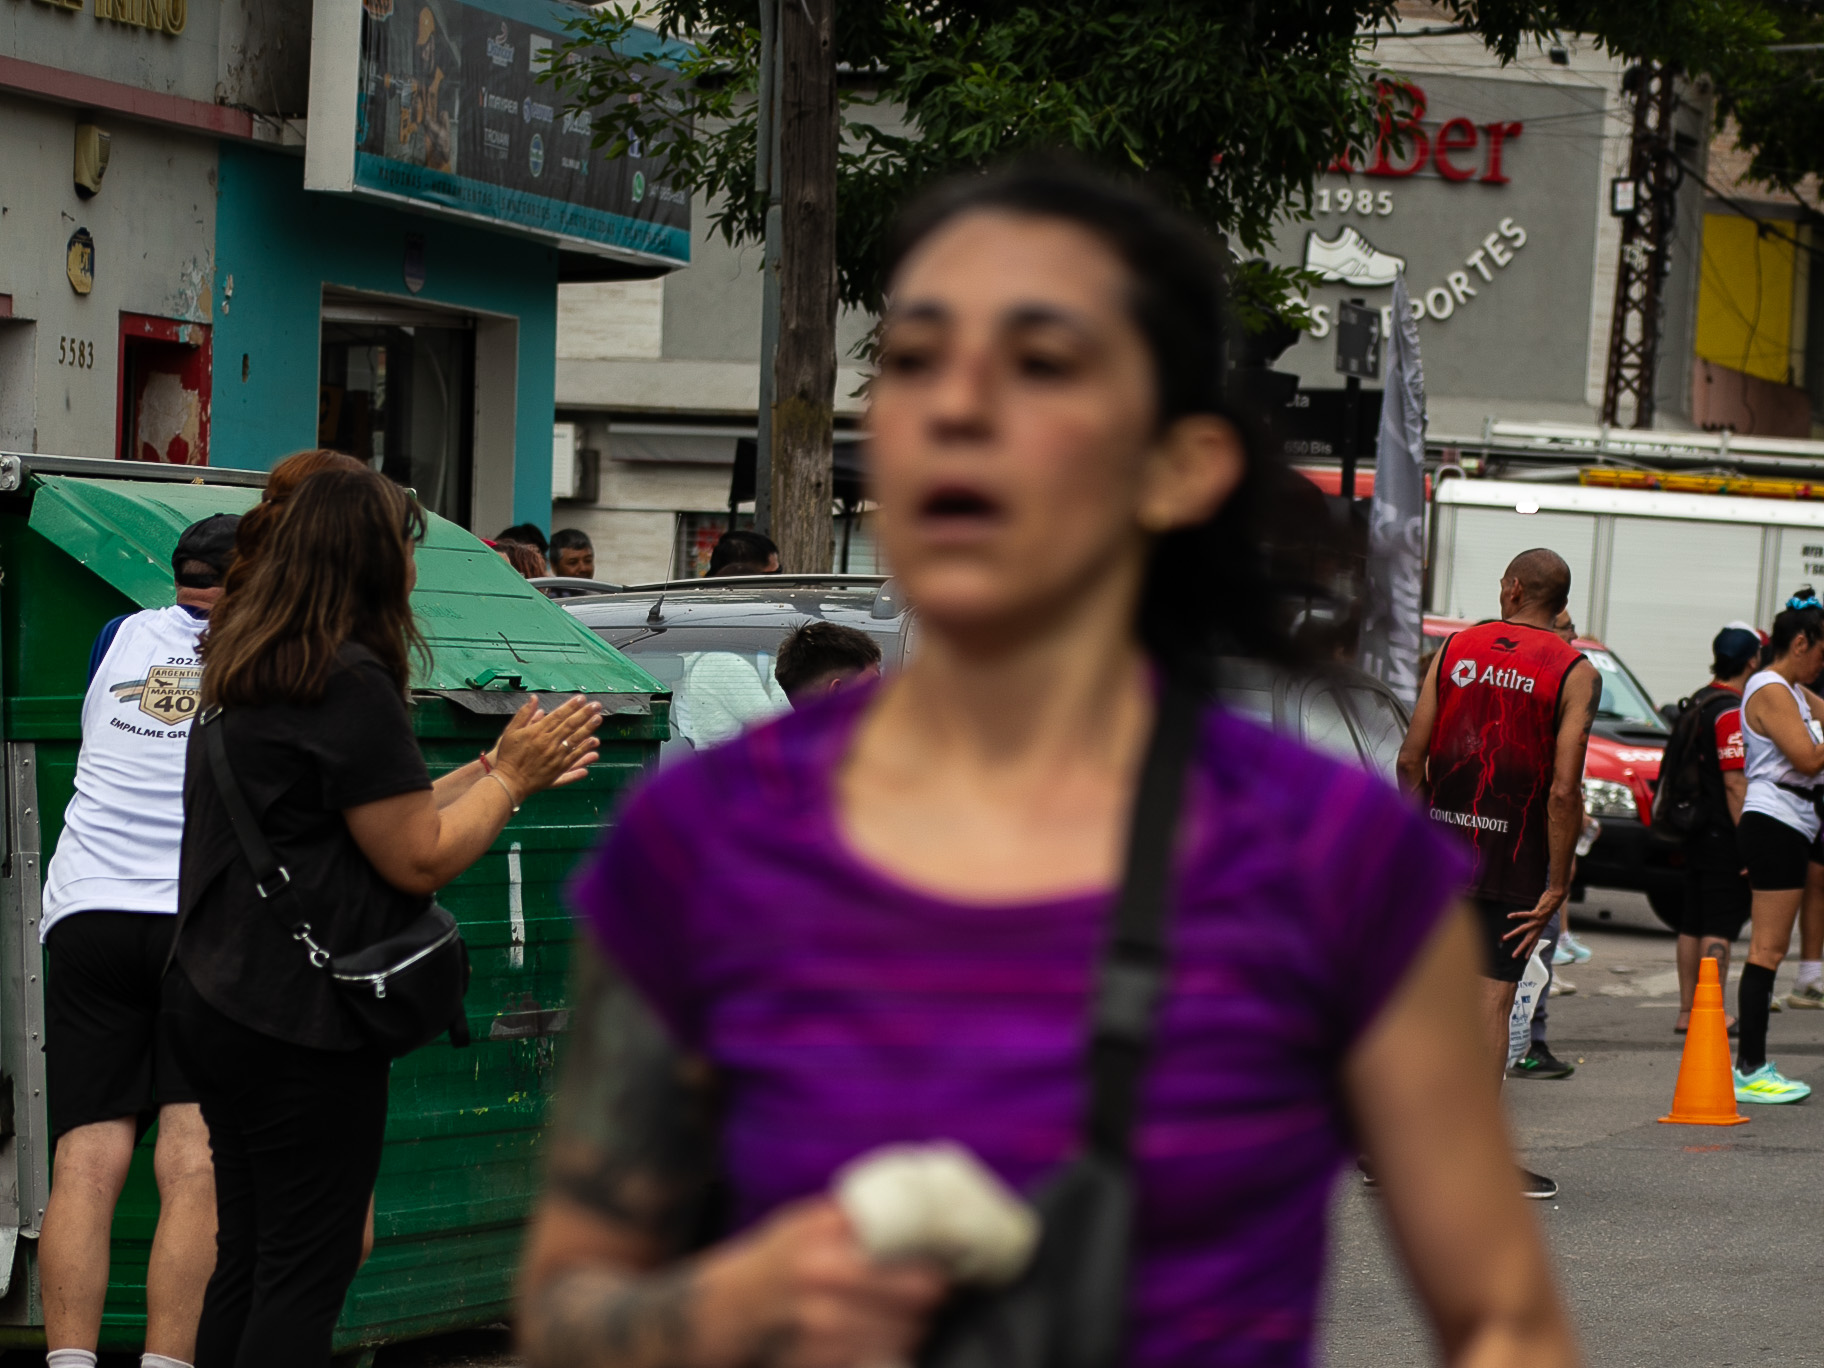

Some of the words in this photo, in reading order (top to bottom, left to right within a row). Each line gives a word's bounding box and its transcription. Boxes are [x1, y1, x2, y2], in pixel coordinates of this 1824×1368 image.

[1318, 188, 1394, 215] 1985
[58, 335, 94, 370] 5583
[155, 669, 203, 678] ARGENTIN
[1479, 665, 1535, 693] Atilra
[153, 696, 196, 713] 40
[109, 717, 164, 739] EMPALME
[167, 730, 188, 739] GR
[1429, 808, 1509, 833] COMUNICANDOTE
